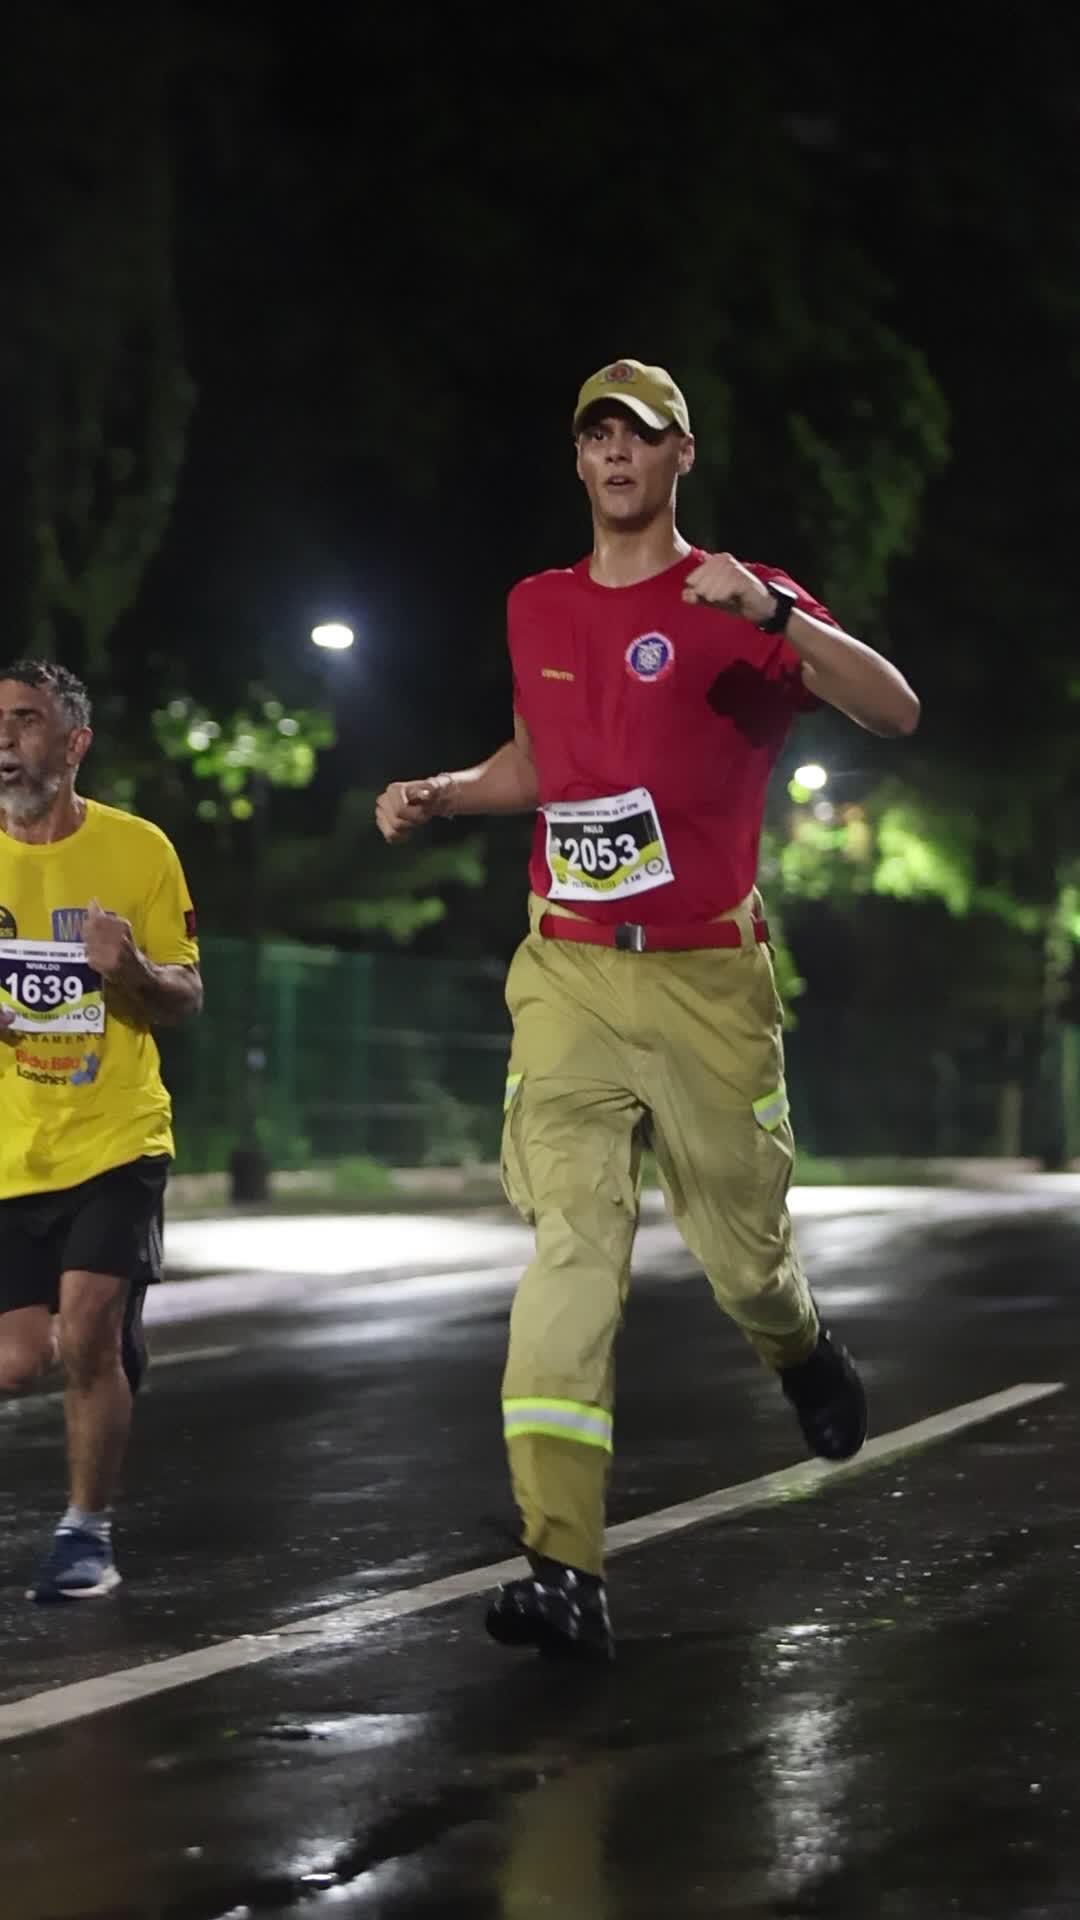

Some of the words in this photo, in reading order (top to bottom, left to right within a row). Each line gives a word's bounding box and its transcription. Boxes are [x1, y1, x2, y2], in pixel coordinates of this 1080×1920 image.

[583, 824, 604, 834] PAULO
[564, 833, 640, 872] 2053
[25, 962, 60, 971] NIVALDO
[5, 972, 84, 1005] 1639
